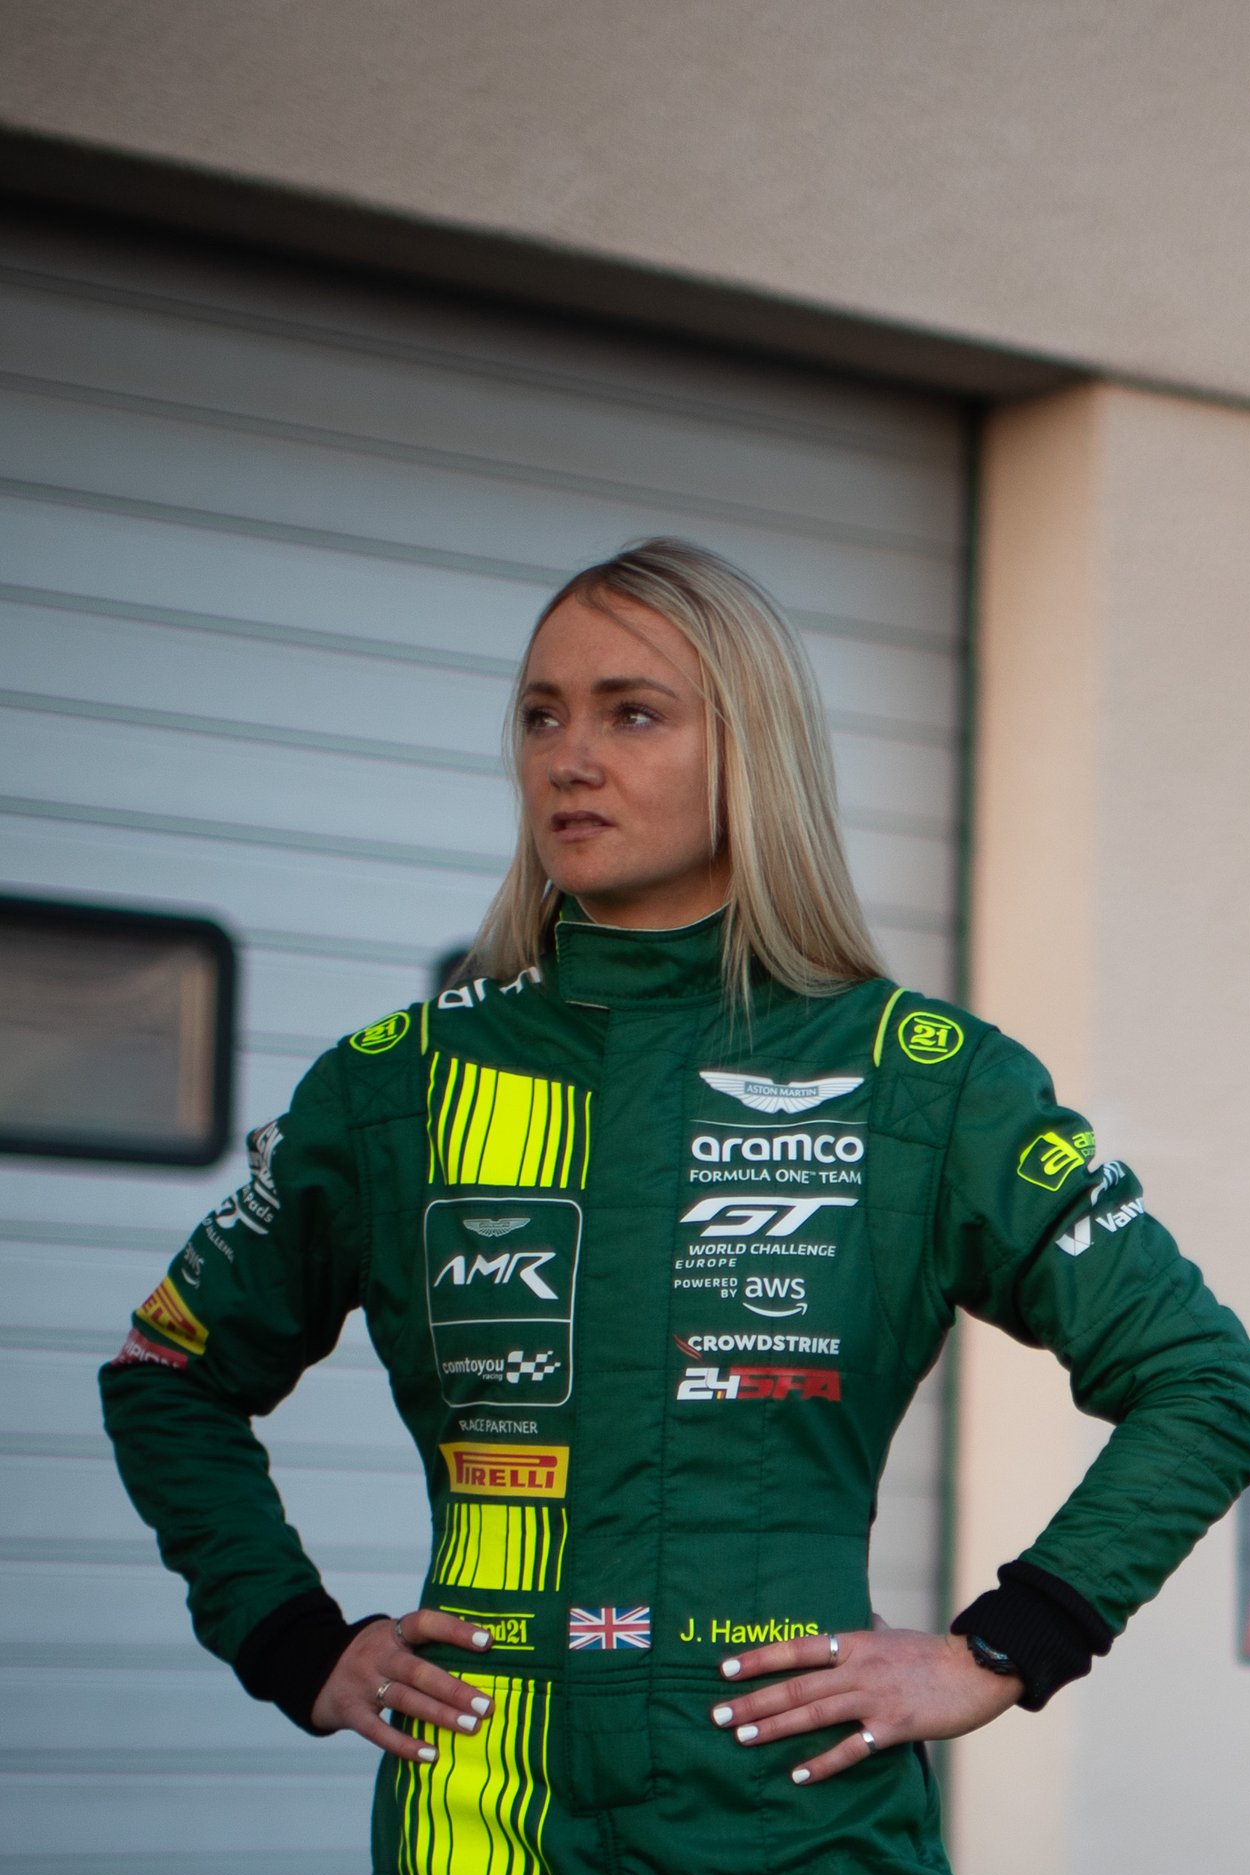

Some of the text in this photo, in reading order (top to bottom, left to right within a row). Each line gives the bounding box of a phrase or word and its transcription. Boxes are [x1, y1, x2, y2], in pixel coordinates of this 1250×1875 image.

[910, 1023, 949, 1048] 21
[746, 1084, 817, 1097] ASTON MARTIN
[691, 1134, 864, 1163] aramco
[689, 1169, 771, 1184] FORMULA
[819, 1171, 862, 1185] TEAM
[680, 1197, 859, 1237] GT
[688, 1242, 836, 1258] WORLD CHALLENGE
[675, 1257, 737, 1269] EUROPE
[674, 1277, 738, 1289] POWERED
[720, 1288, 738, 1299] BY
[745, 1276, 806, 1300] aws
[687, 1334, 841, 1355] CROWDSTRIKE
[442, 1355, 505, 1377] comtoyou
[482, 1372, 504, 1382] racing
[453, 1451, 558, 1490] PIRELLI
[680, 1617, 819, 1644] J. Hawkins
